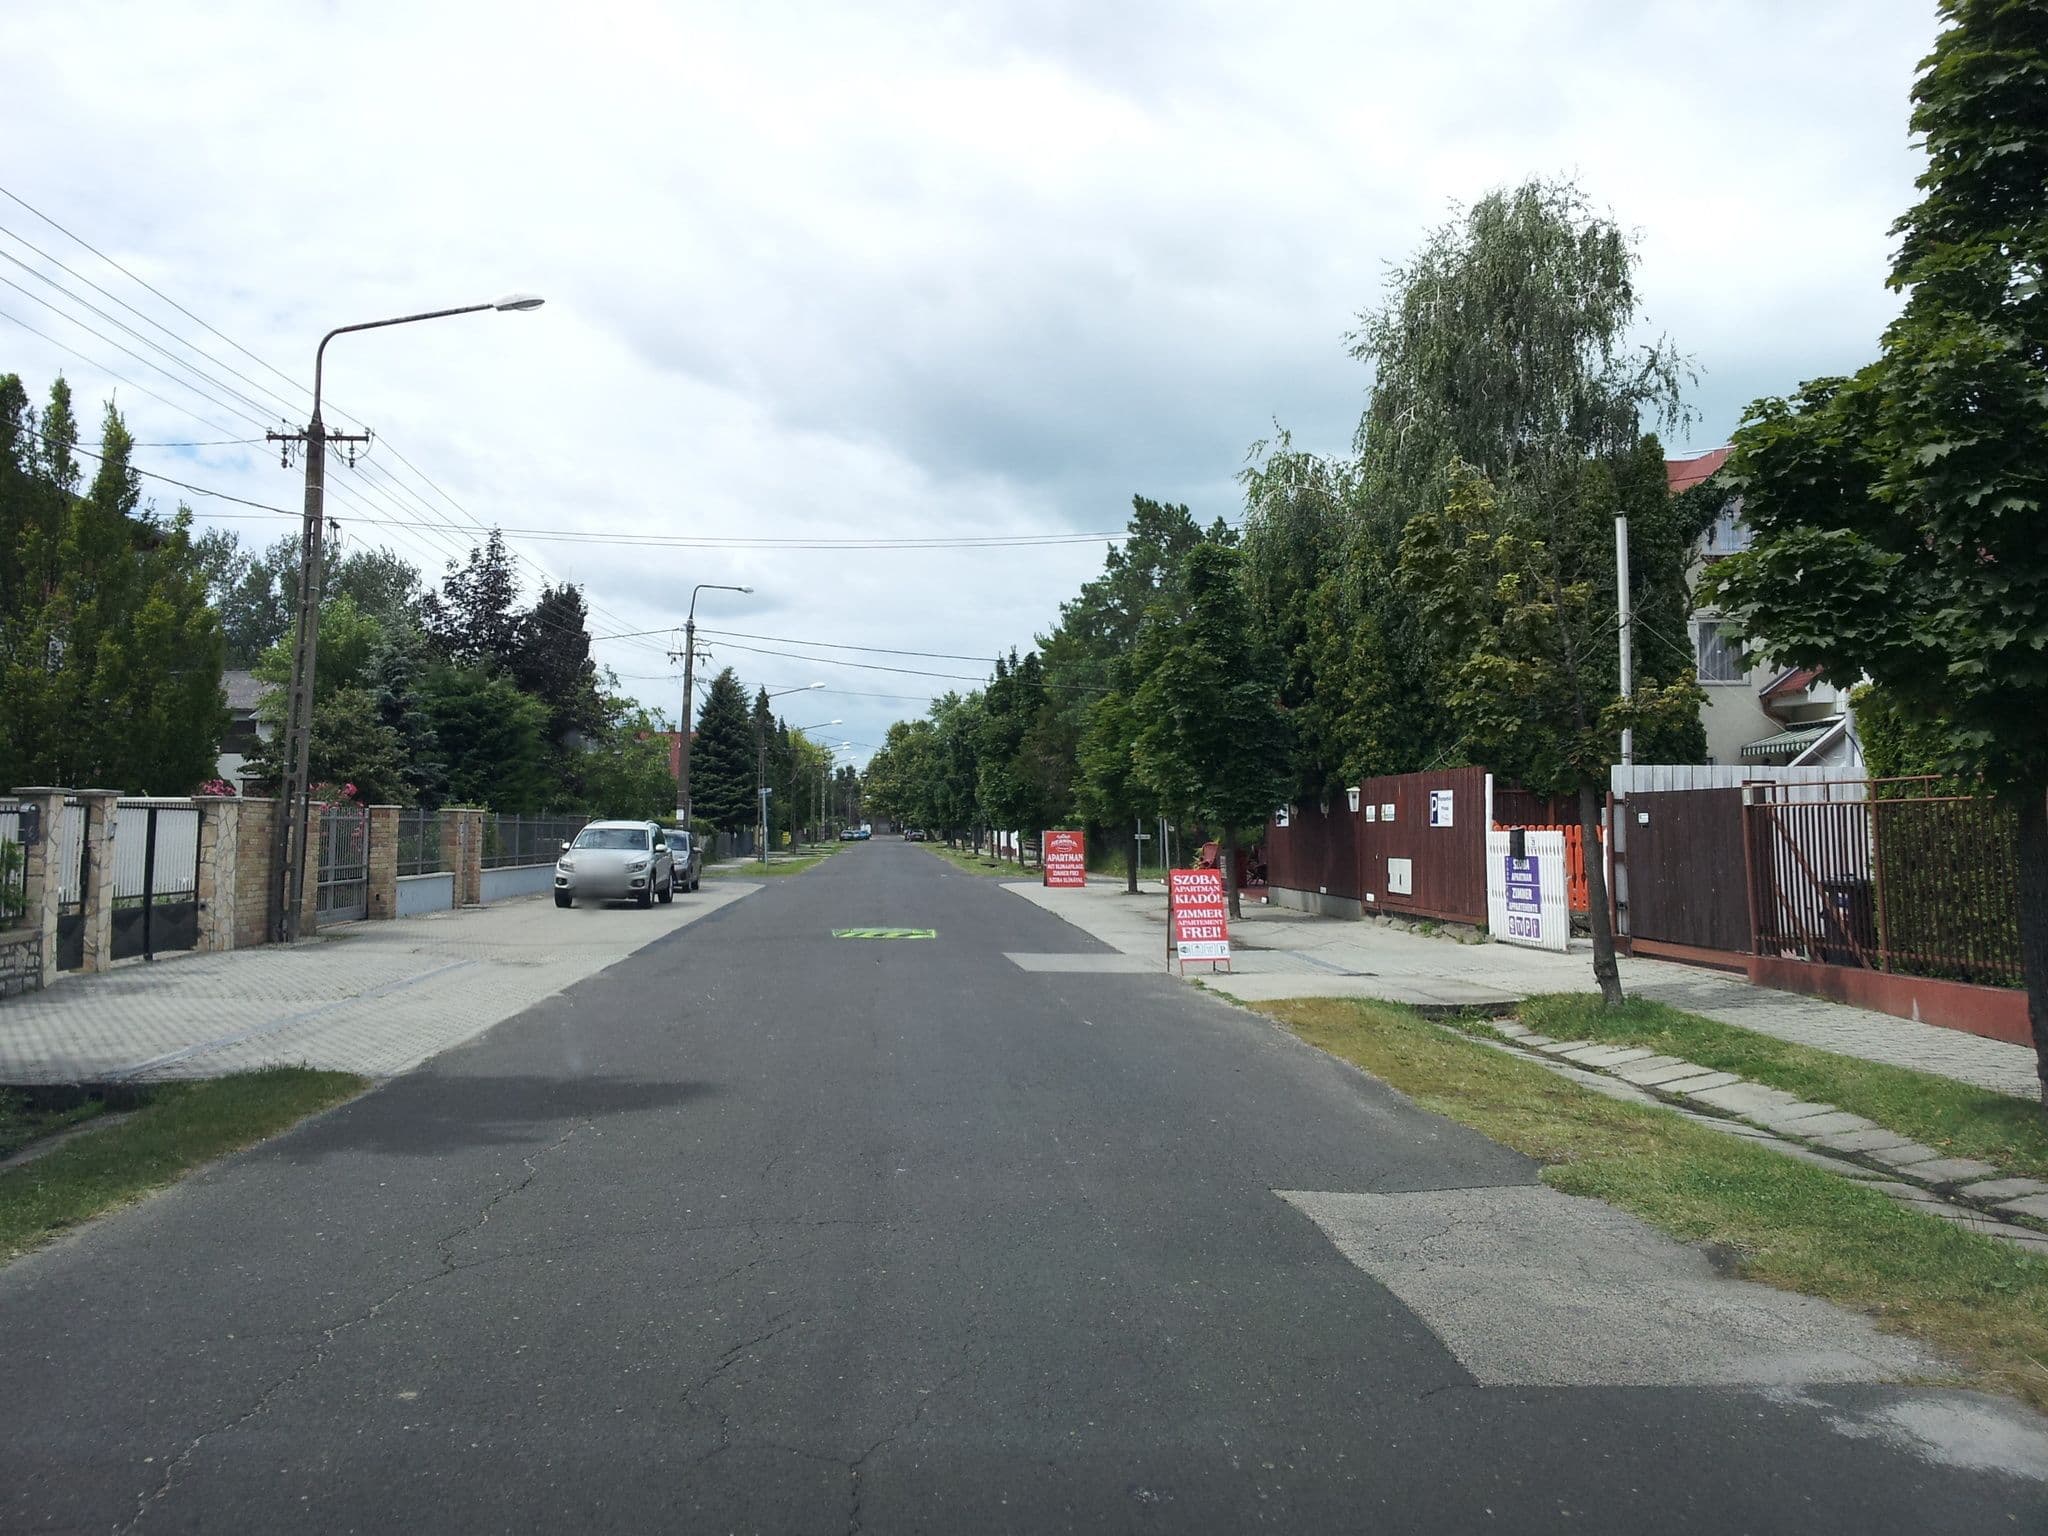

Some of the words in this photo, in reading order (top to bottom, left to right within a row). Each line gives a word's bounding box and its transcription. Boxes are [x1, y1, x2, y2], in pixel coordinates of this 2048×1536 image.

[1431, 796, 1438, 821] P
[1047, 853, 1084, 862] APARTMAN
[1512, 858, 1530, 870] SZOBA
[1173, 874, 1219, 885] SZOBA
[1174, 885, 1220, 893] APARTMAN
[1512, 887, 1533, 900] ZIMMER
[1175, 892, 1221, 904] KIADÓ!
[1177, 909, 1223, 918] ZIMMER
[1182, 926, 1222, 938] FREI!
